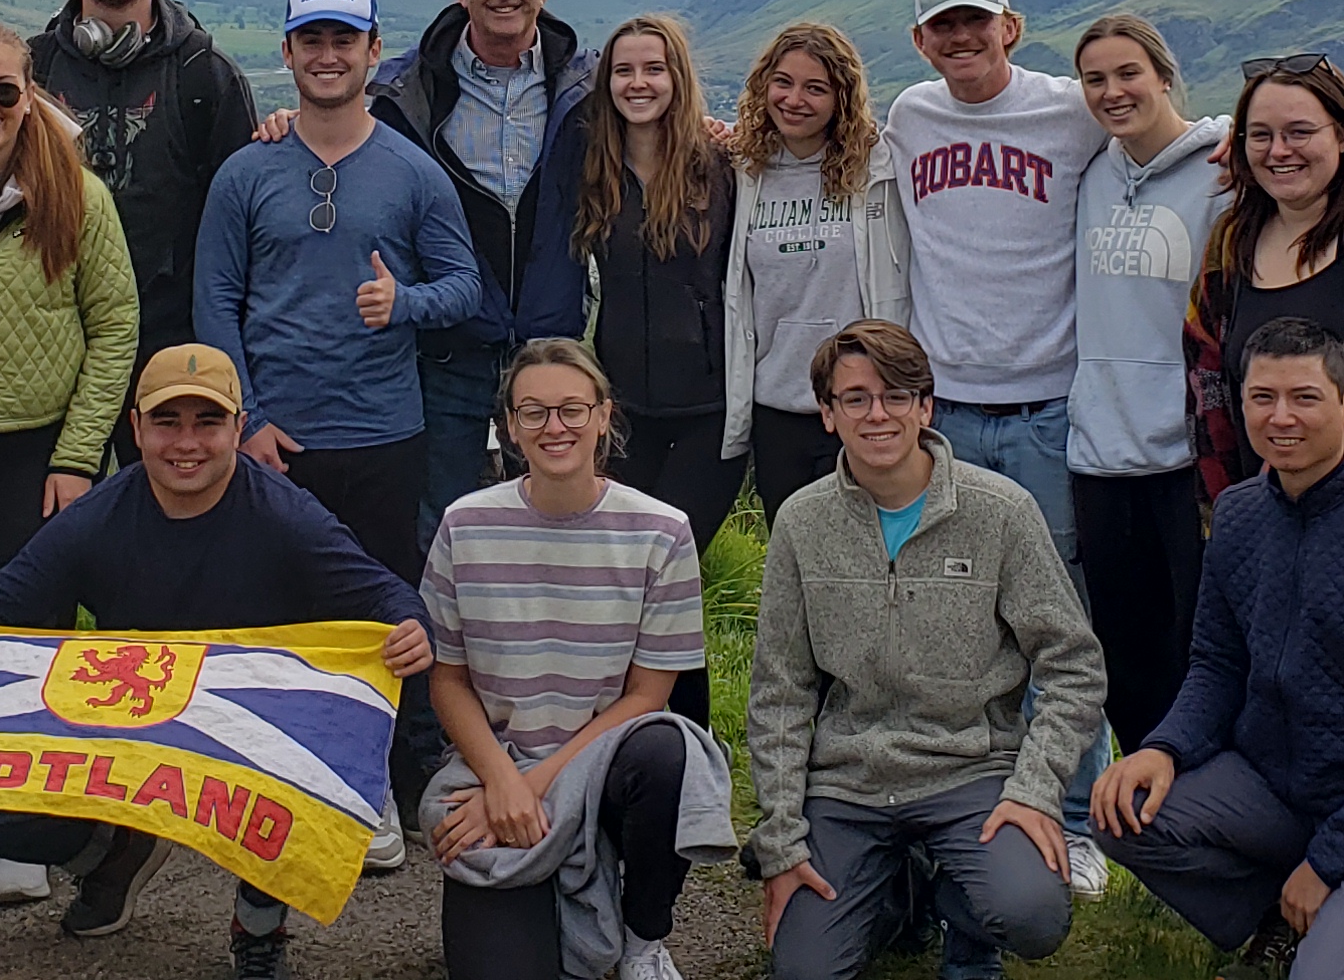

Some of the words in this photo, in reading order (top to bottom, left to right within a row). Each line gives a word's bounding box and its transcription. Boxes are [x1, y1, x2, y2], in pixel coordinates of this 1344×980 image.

[911, 141, 1053, 207] HOBART
[747, 198, 813, 235] ILLIAM
[819, 195, 851, 222] SMI
[1111, 204, 1154, 226] THE
[1090, 250, 1140, 276] FACE
